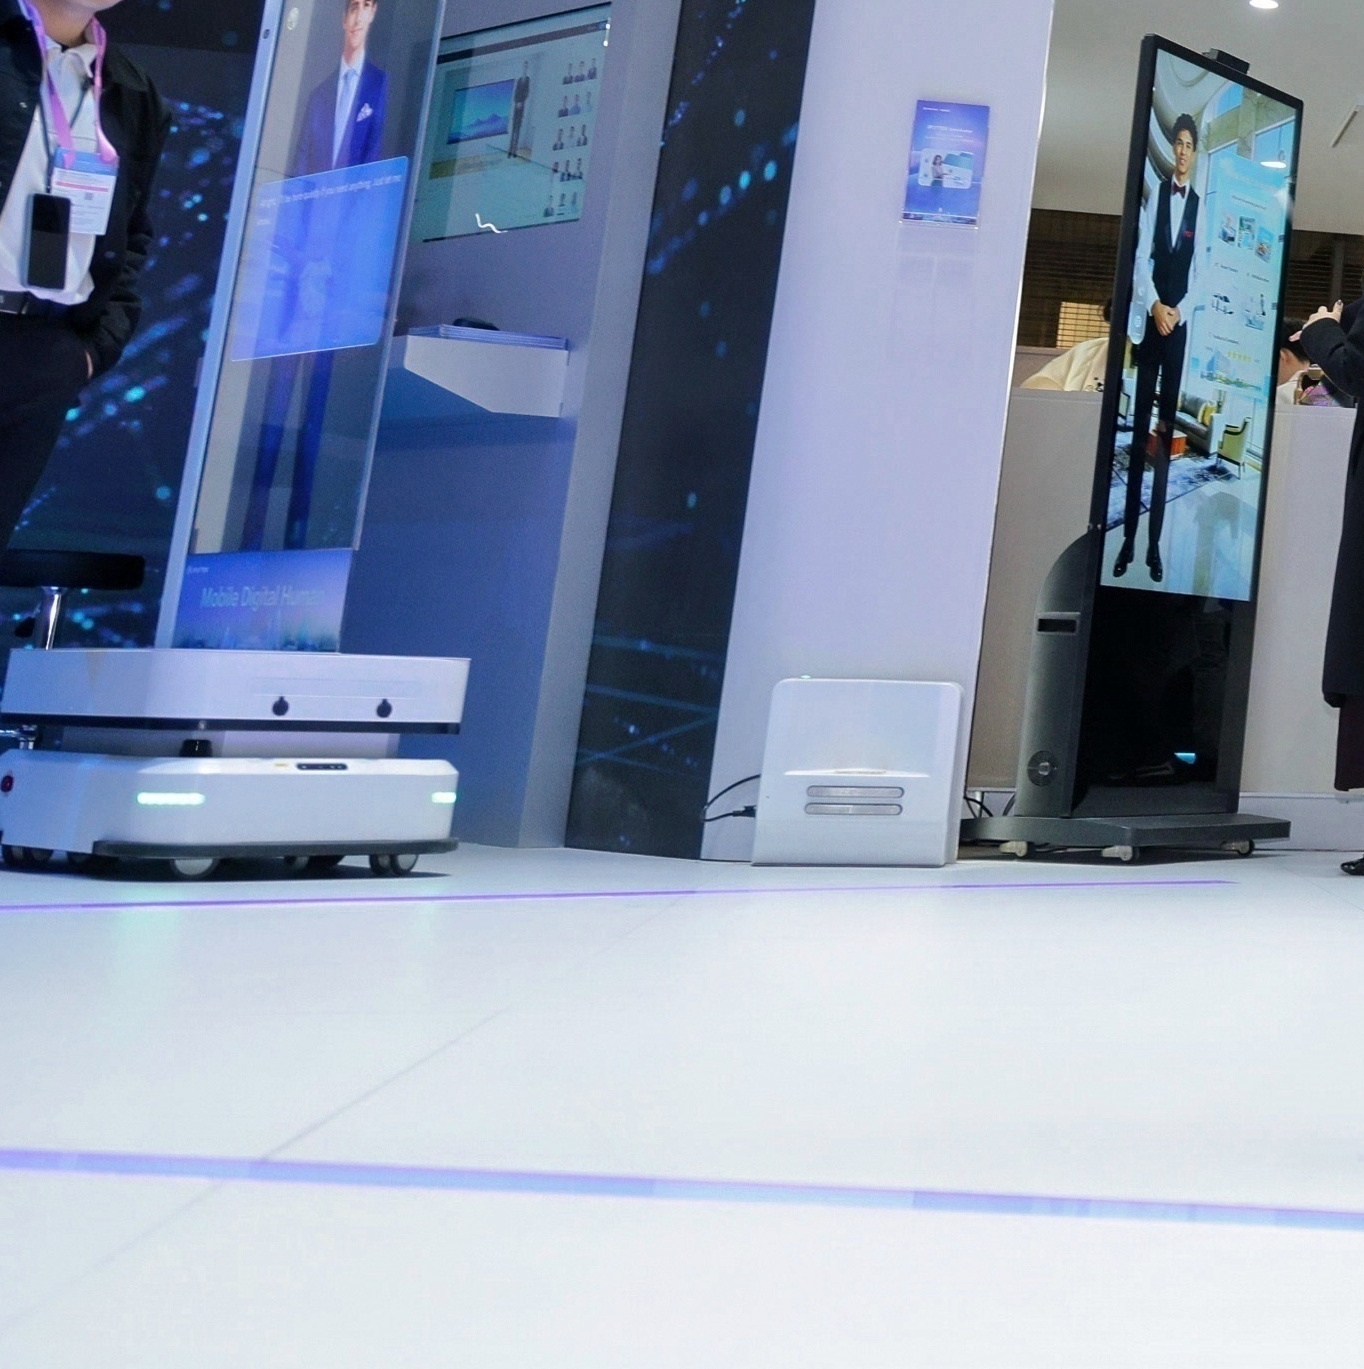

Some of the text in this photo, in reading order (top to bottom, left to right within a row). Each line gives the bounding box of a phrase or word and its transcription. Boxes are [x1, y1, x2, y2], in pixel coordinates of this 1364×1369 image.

[201, 585, 325, 611] Mobile Digital Human
